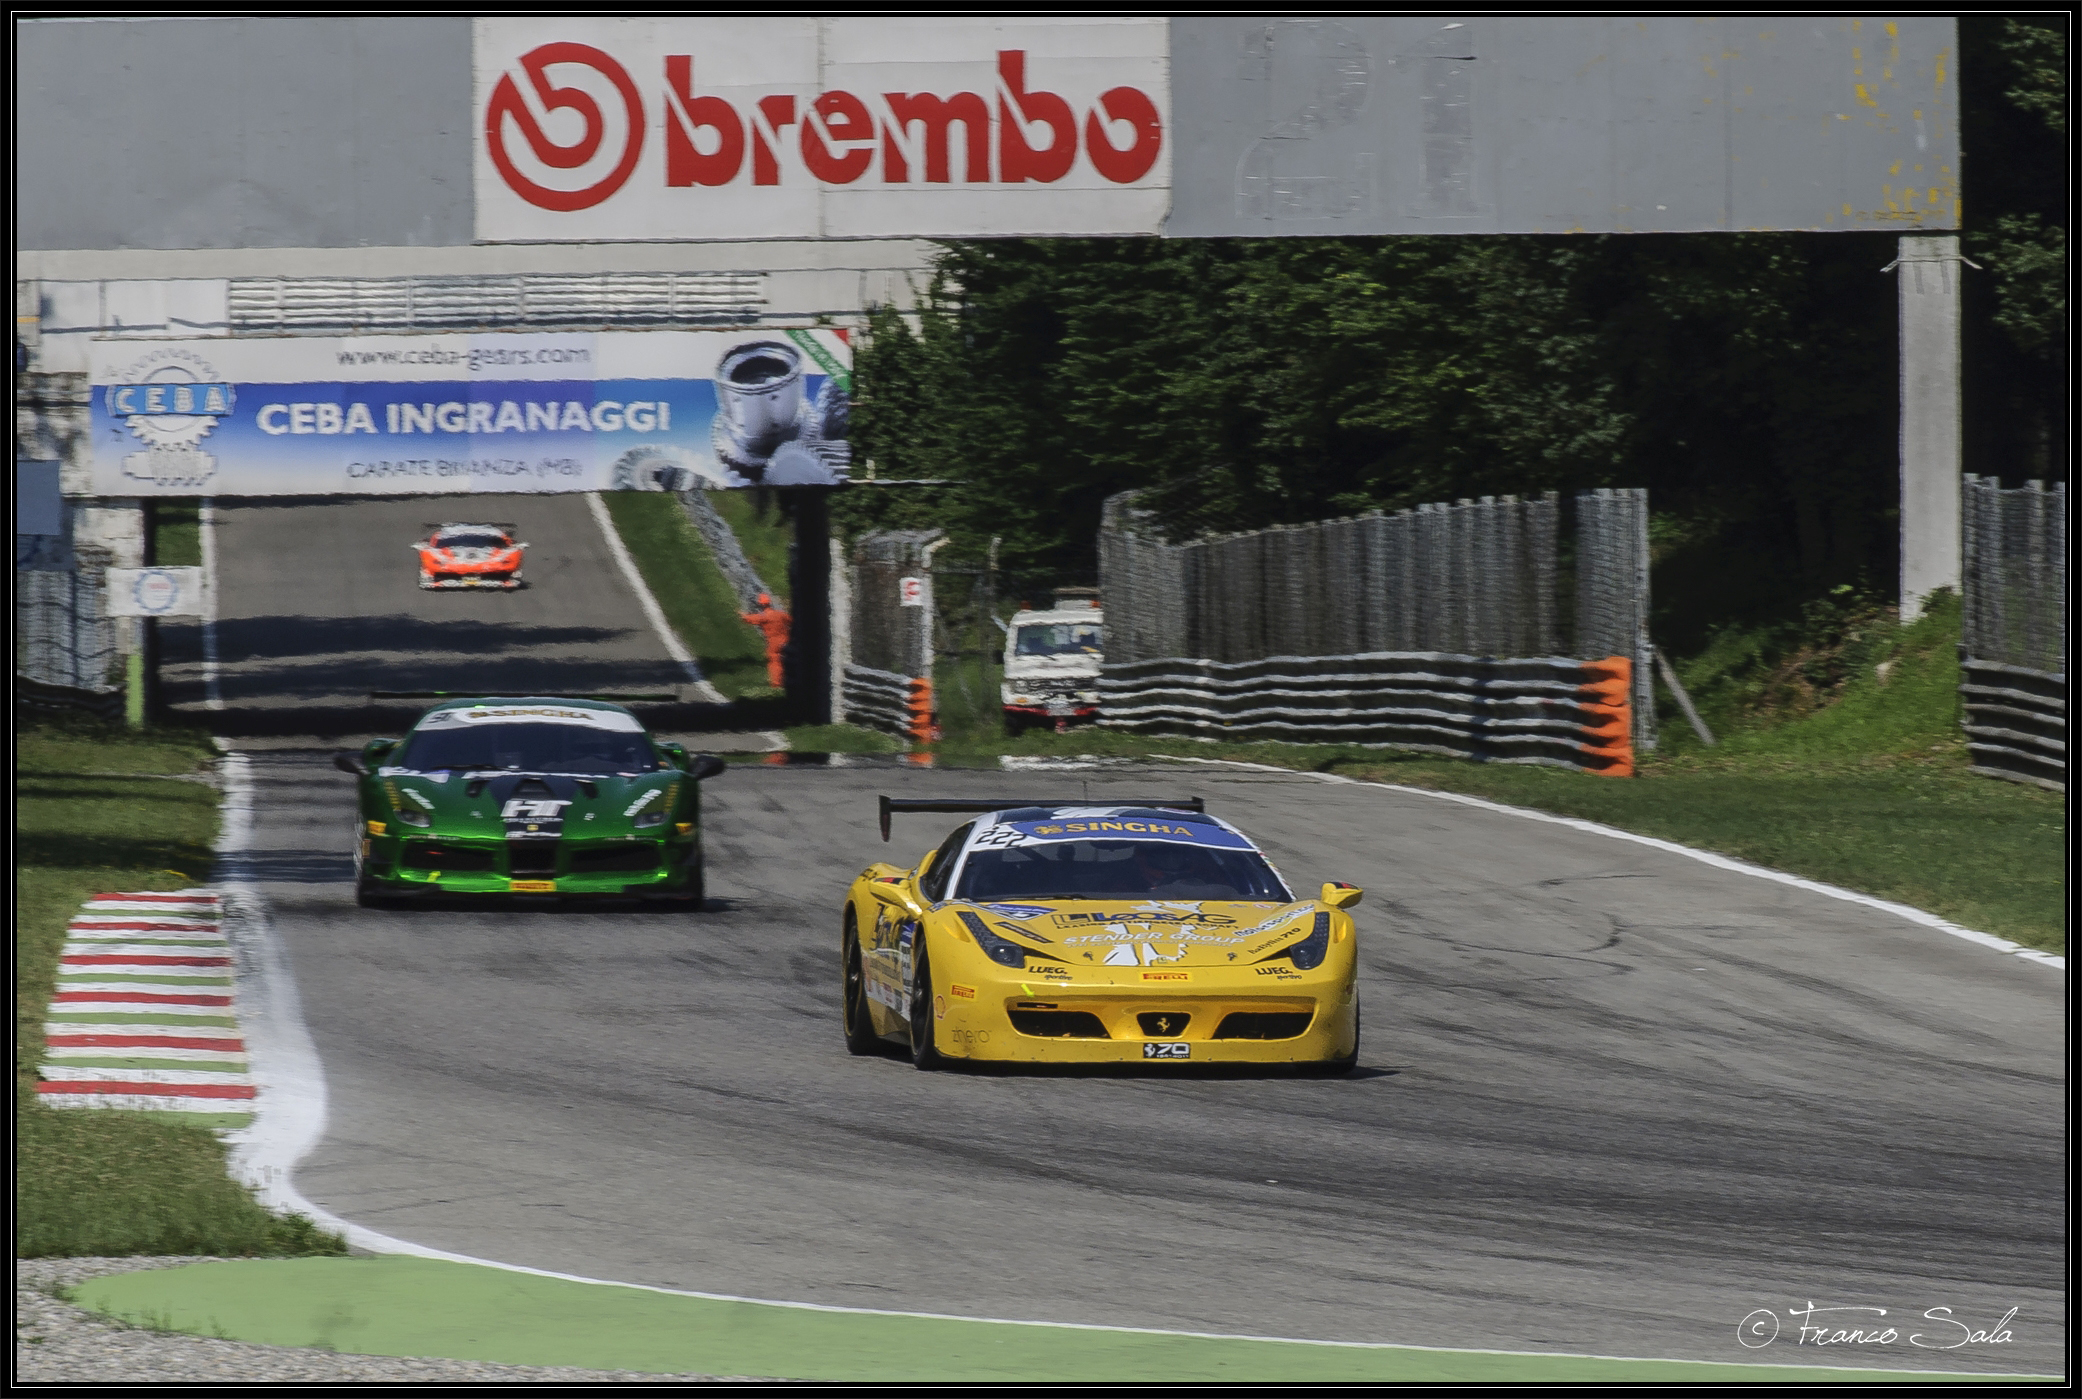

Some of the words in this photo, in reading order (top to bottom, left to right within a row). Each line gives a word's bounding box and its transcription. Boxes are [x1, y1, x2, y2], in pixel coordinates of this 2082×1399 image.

[664, 50, 1161, 187] brembo
[336, 343, 592, 372] www.ceba-gears.com
[115, 386, 226, 414] CEBA
[256, 402, 379, 435] CEBA
[386, 400, 672, 434] INGRANAGGI
[346, 459, 433, 478] CARATE
[500, 800, 573, 817] HT
[1066, 821, 1195, 837] SINGHA
[974, 830, 1028, 848] 222
[1063, 931, 1163, 945] STENDER
[1169, 933, 1246, 945] GROUP
[1142, 973, 1189, 981] PIRELLI
[1157, 1043, 1189, 1054] 70
